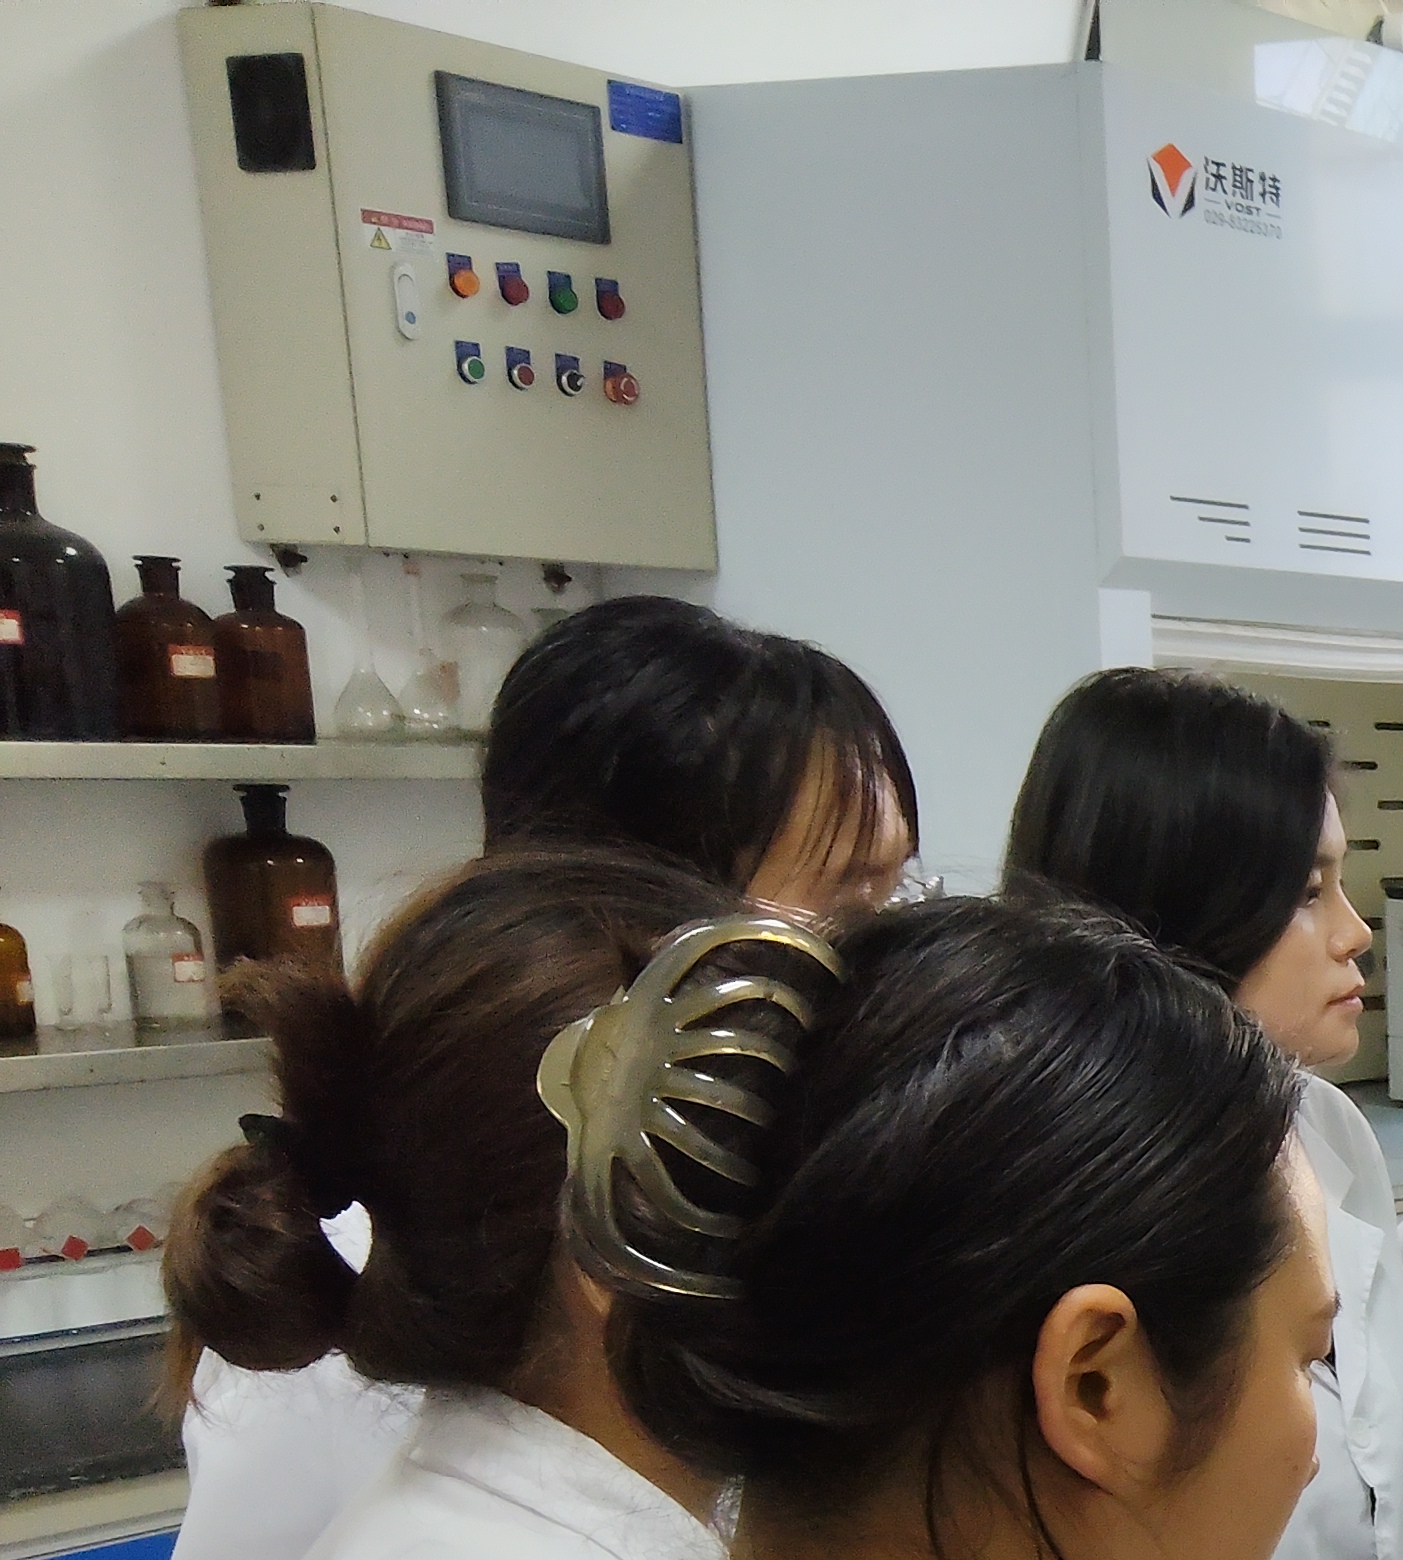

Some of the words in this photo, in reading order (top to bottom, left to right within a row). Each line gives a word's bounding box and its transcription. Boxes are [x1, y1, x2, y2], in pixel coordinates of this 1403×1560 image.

[1203, 155, 1281, 208] 沃斯特
[1225, 199, 1262, 217] VOST
